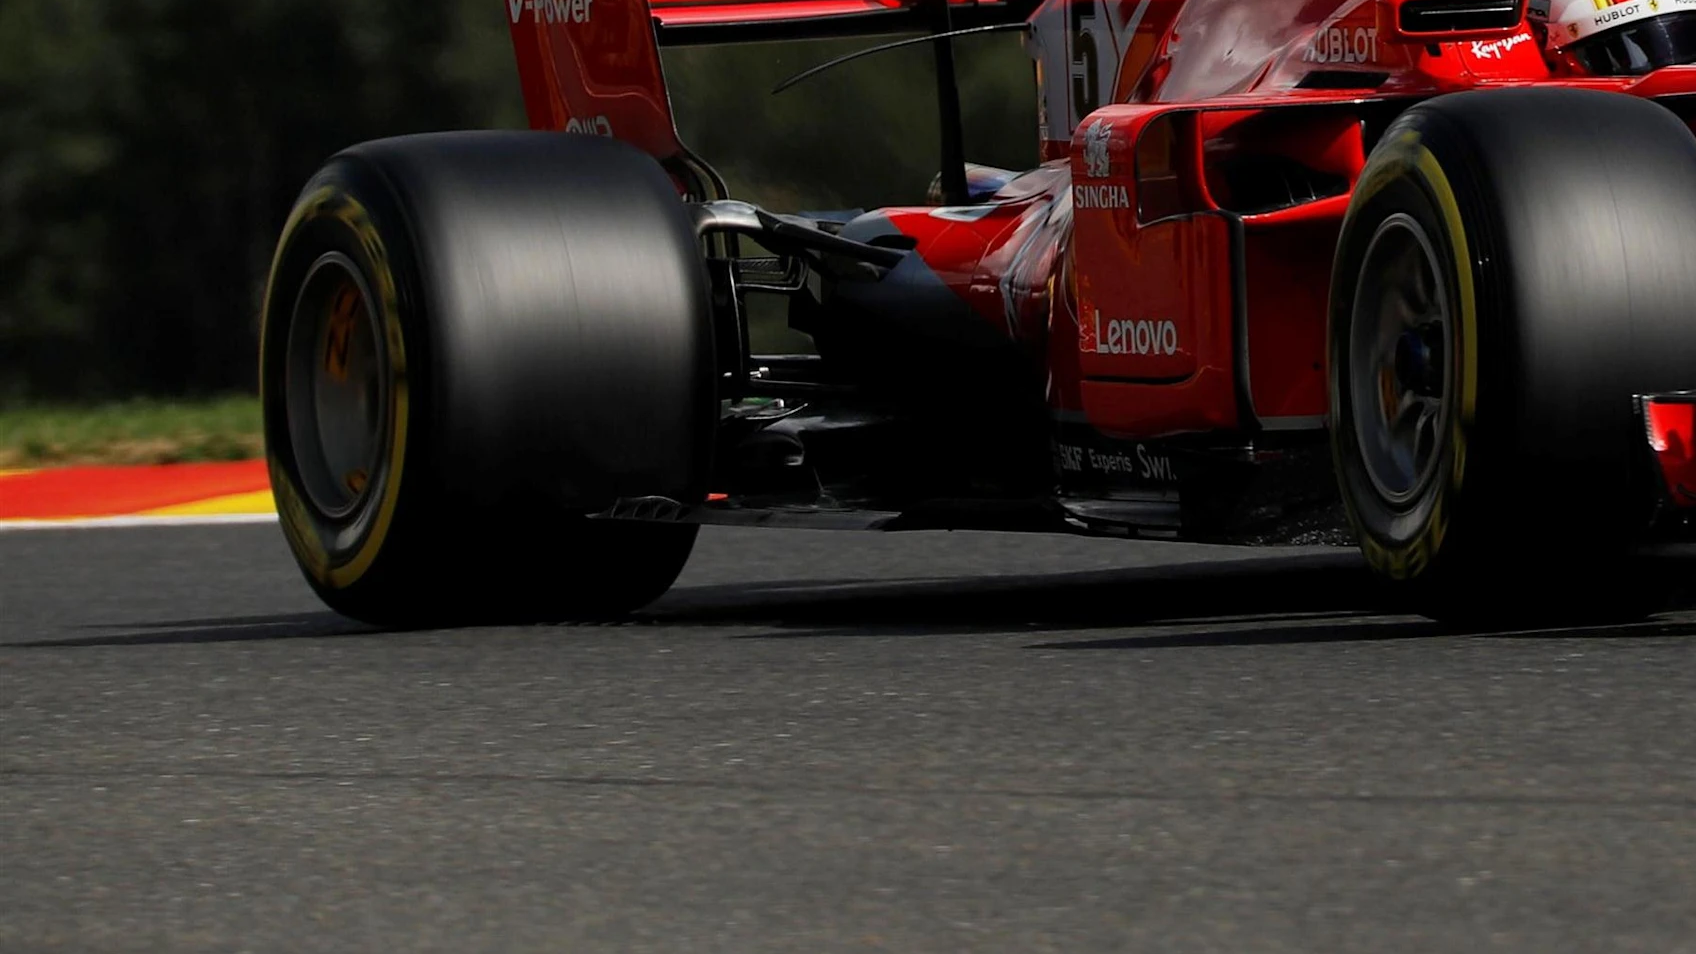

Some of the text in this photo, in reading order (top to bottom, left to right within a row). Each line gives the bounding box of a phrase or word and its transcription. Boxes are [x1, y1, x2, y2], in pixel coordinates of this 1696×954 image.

[1594, 4, 1641, 26] HUBLOT
[1076, 184, 1130, 209] SINGHA
[1095, 309, 1177, 355] Lenovo
[1088, 448, 1133, 474] Experis
